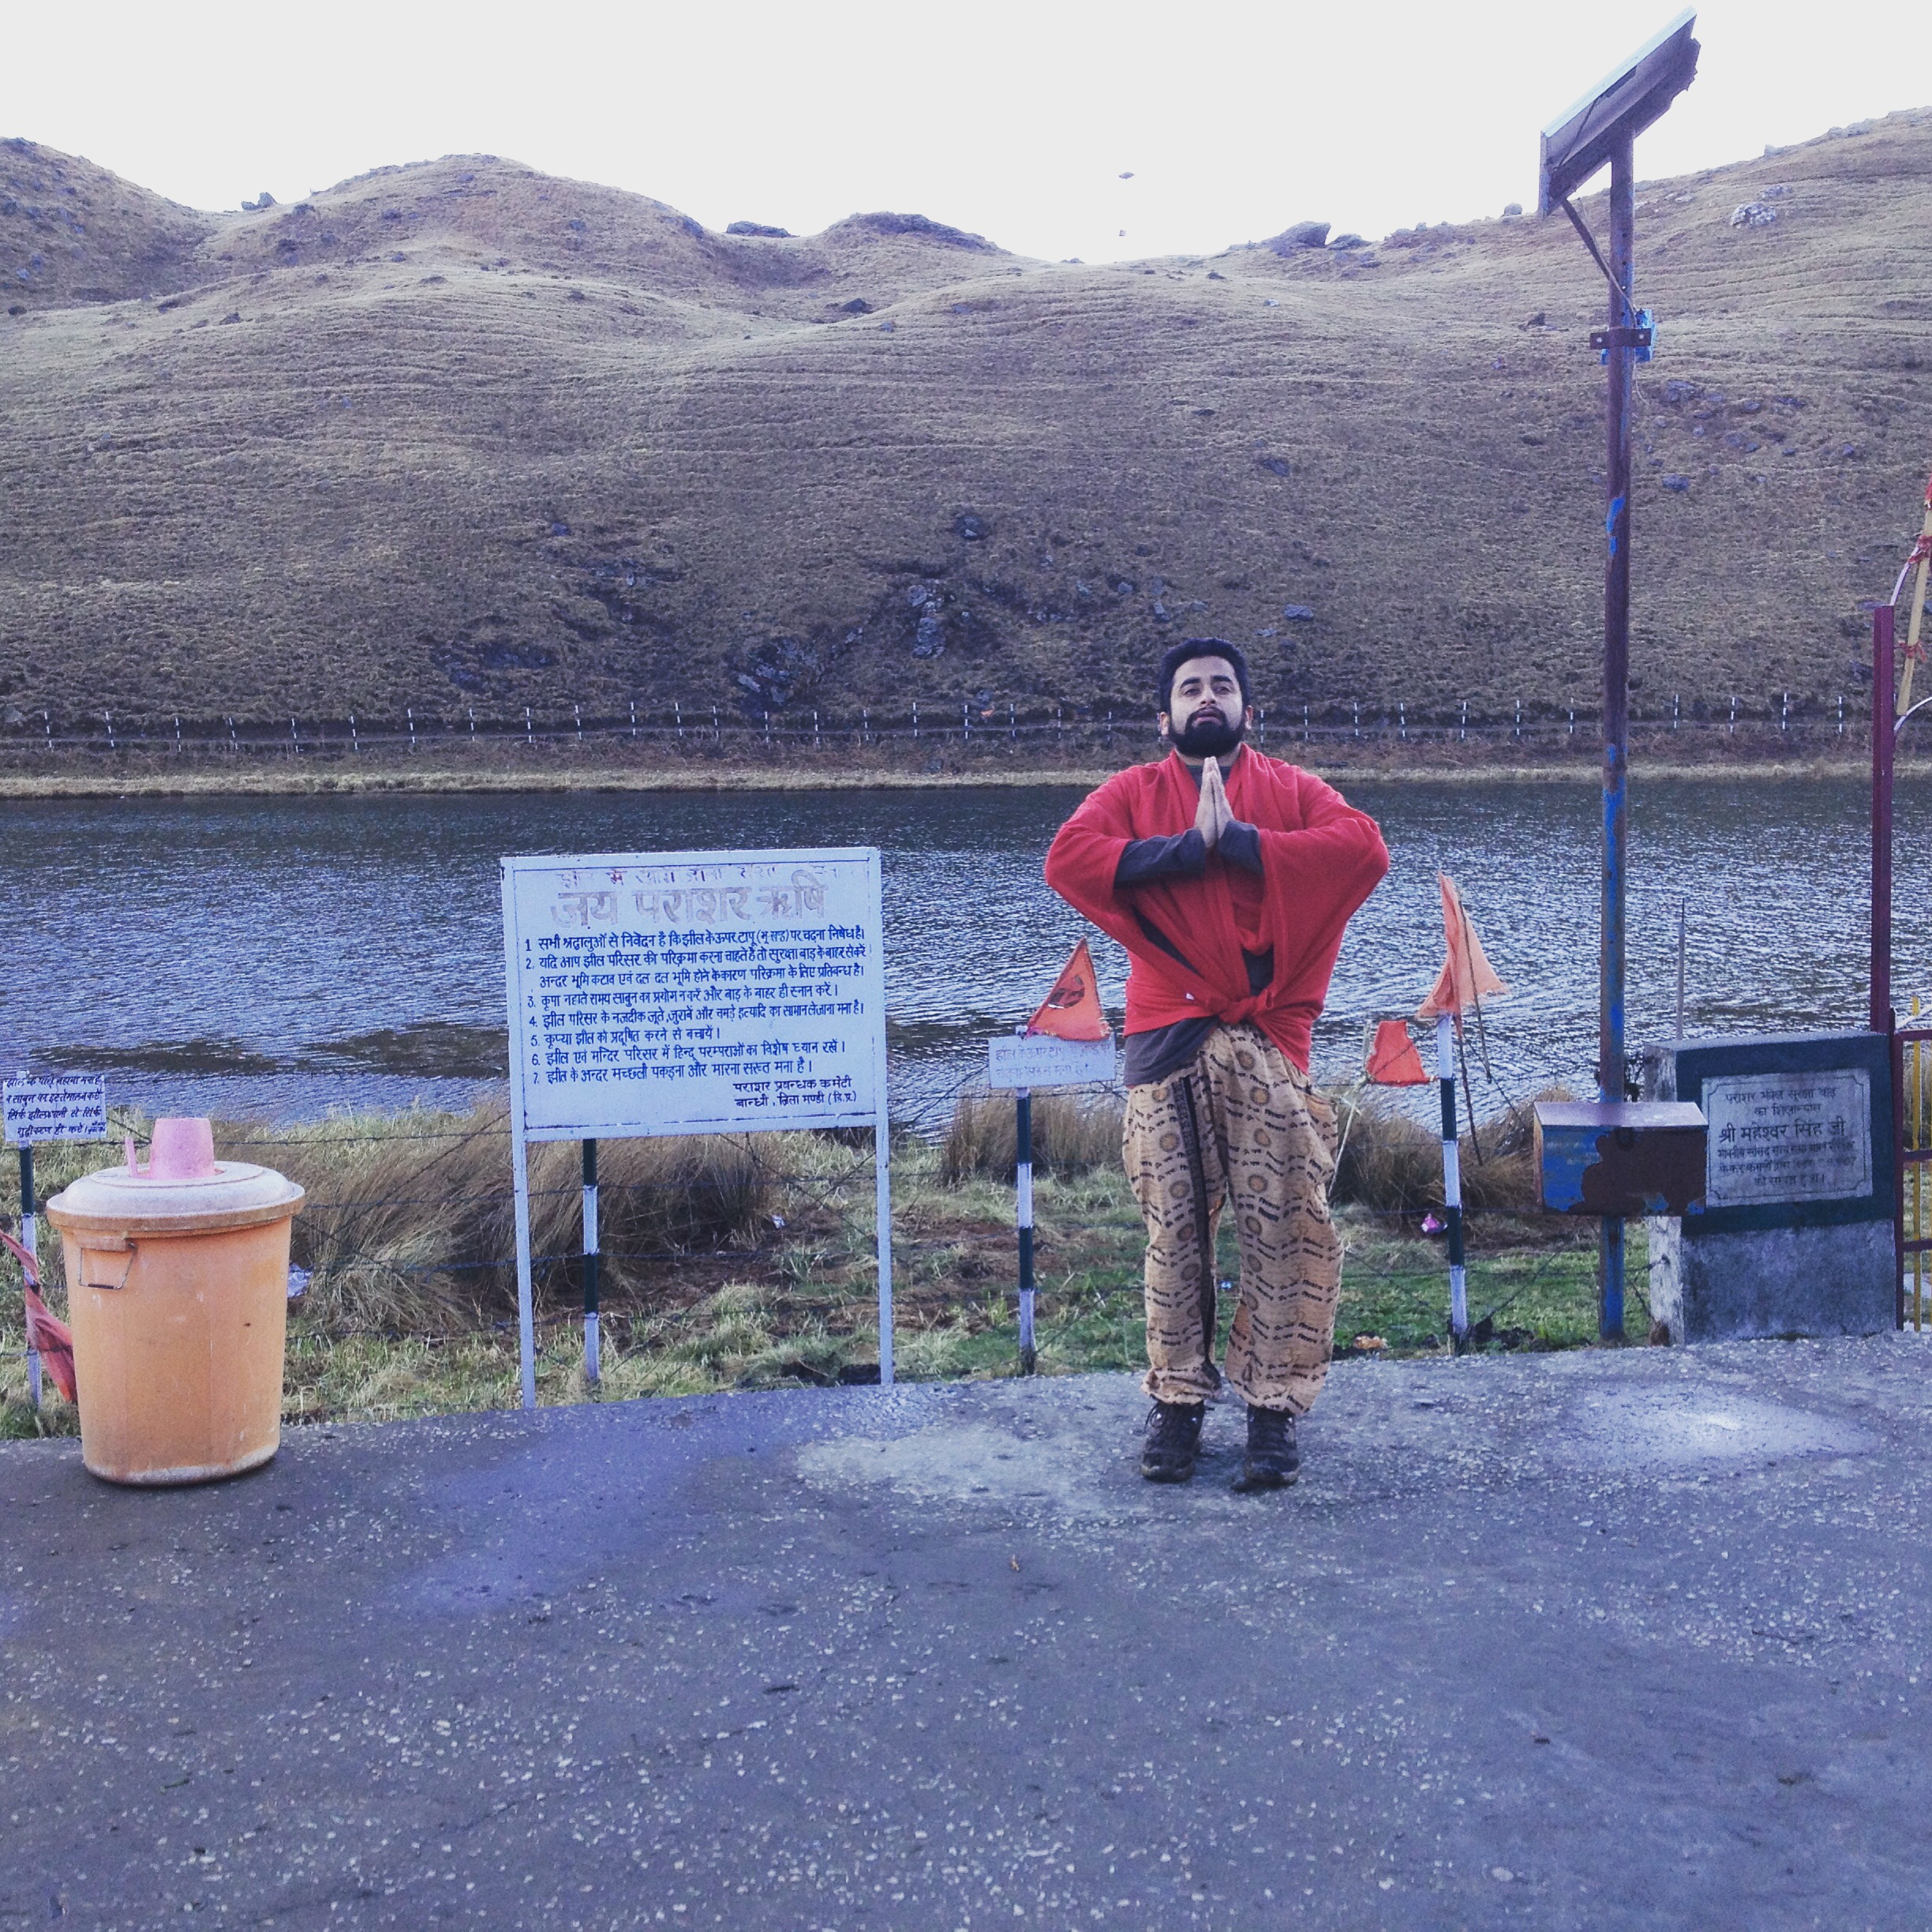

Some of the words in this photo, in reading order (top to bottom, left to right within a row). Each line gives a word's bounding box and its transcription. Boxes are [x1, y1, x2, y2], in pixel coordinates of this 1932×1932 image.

[550, 891, 618, 927] जय
[632, 889, 751, 924] पराशर
[757, 870, 829, 919] ऋषि
[538, 934, 560, 950] सभी
[608, 932, 619, 947] से
[621, 931, 655, 948] निवेदन
[658, 931, 666, 947] है
[668, 930, 681, 947] कि
[681, 930, 704, 946] झील
[705, 929, 715, 944] के
[715, 932, 736, 944] ऊपर
[738, 931, 757, 947] टापू
[791, 931, 803, 942] पर
[829, 924, 855, 940] निषेध
[539, 954, 557, 969] यदि
[560, 956, 580, 968] आप
[583, 953, 605, 968] झील
[607, 950, 642, 967] परिसर
[644, 951, 657, 965] की
[661, 949, 697, 967] परिक्रमा
[699, 951, 723, 964] करना
[725, 947, 748, 961] चाहते
[757, 946, 767, 960] तो
[817, 945, 826, 958] के
[825, 946, 846, 960] बाहर
[846, 945, 854, 957] से
[540, 975, 568, 987] अन्दर
[571, 972, 590, 989] भूमि
[591, 975, 615, 985] कटाव
[619, 971, 633, 984] एवं
[635, 973, 650, 984] दल
[672, 968, 691, 986] भूमि
[694, 968, 710, 983] होने
[712, 968, 721, 981] के
[721, 969, 747, 981] कारण
[751, 965, 786, 980] परिक्रमा
[788, 964, 797, 979] के
[799, 964, 815, 978] लिए
[818, 963, 852, 977] प्रतिबन्ध
[541, 995, 560, 1010] कृपा
[564, 991, 588, 1006] नहाते
[590, 993, 611, 1005] समय
[612, 993, 638, 1007] साबुन
[639, 993, 650, 1003] का
[653, 988, 677, 1003] प्रयोग
[679, 990, 686, 1002] न
[687, 988, 701, 1002] करें
[704, 986, 722, 1002] और
[743, 985, 752, 1000] के
[754, 988, 776, 998] बाहर
[779, 983, 788, 998] ही
[790, 986, 813, 998] स्नान
[542, 1011, 565, 1029] झील
[568, 1010, 597, 1026] परिसर
[601, 1010, 610, 1023] के
[647, 1006, 664, 1023] जूते
[696, 1007, 713, 1020] और
[739, 1003, 766, 1020] इत्यादि
[769, 1005, 781, 1017] का
[783, 1005, 807, 1017] सामान
[807, 1001, 817, 1016] ले
[815, 1004, 835, 1016] जाना
[837, 1002, 852, 1015] मना
[544, 1033, 572, 1049] कृप्या
[575, 1030, 595, 1046] झील
[597, 1029, 608, 1043] को
[644, 1028, 668, 1042] करने
[672, 1027, 683, 1040] से
[545, 1048, 569, 1066] झील
[591, 1046, 620, 1063] मन्दिर
[623, 1045, 658, 1061] परिसर
[662, 1044, 671, 1059] में
[673, 1045, 698, 1062] हिन्दू
[698, 1042, 745, 1058] परम्पराओं
[747, 1044, 758, 1055] का
[761, 1039, 789, 1054] विशेष
[546, 1067, 567, 1084] झील
[571, 1067, 578, 1082] के
[581, 1069, 608, 1082] अन्दर
[651, 1065, 685, 1080] पकड़ना
[688, 1061, 707, 1076] और
[711, 1064, 740, 1076] मारना
[774, 1061, 793, 1073] मना
[733, 1081, 771, 1093] पराशर
[819, 1075, 852, 1088] कमेटी
[13, 1095, 36, 1107] साबुन
[802, 1091, 825, 1104] मण्डी
[1719, 1121, 1736, 1143] श्री
[1740, 1121, 1789, 1141] महेश्वर
[1794, 1118, 1823, 1137] सिंह
[1828, 1114, 1846, 1136] जी
